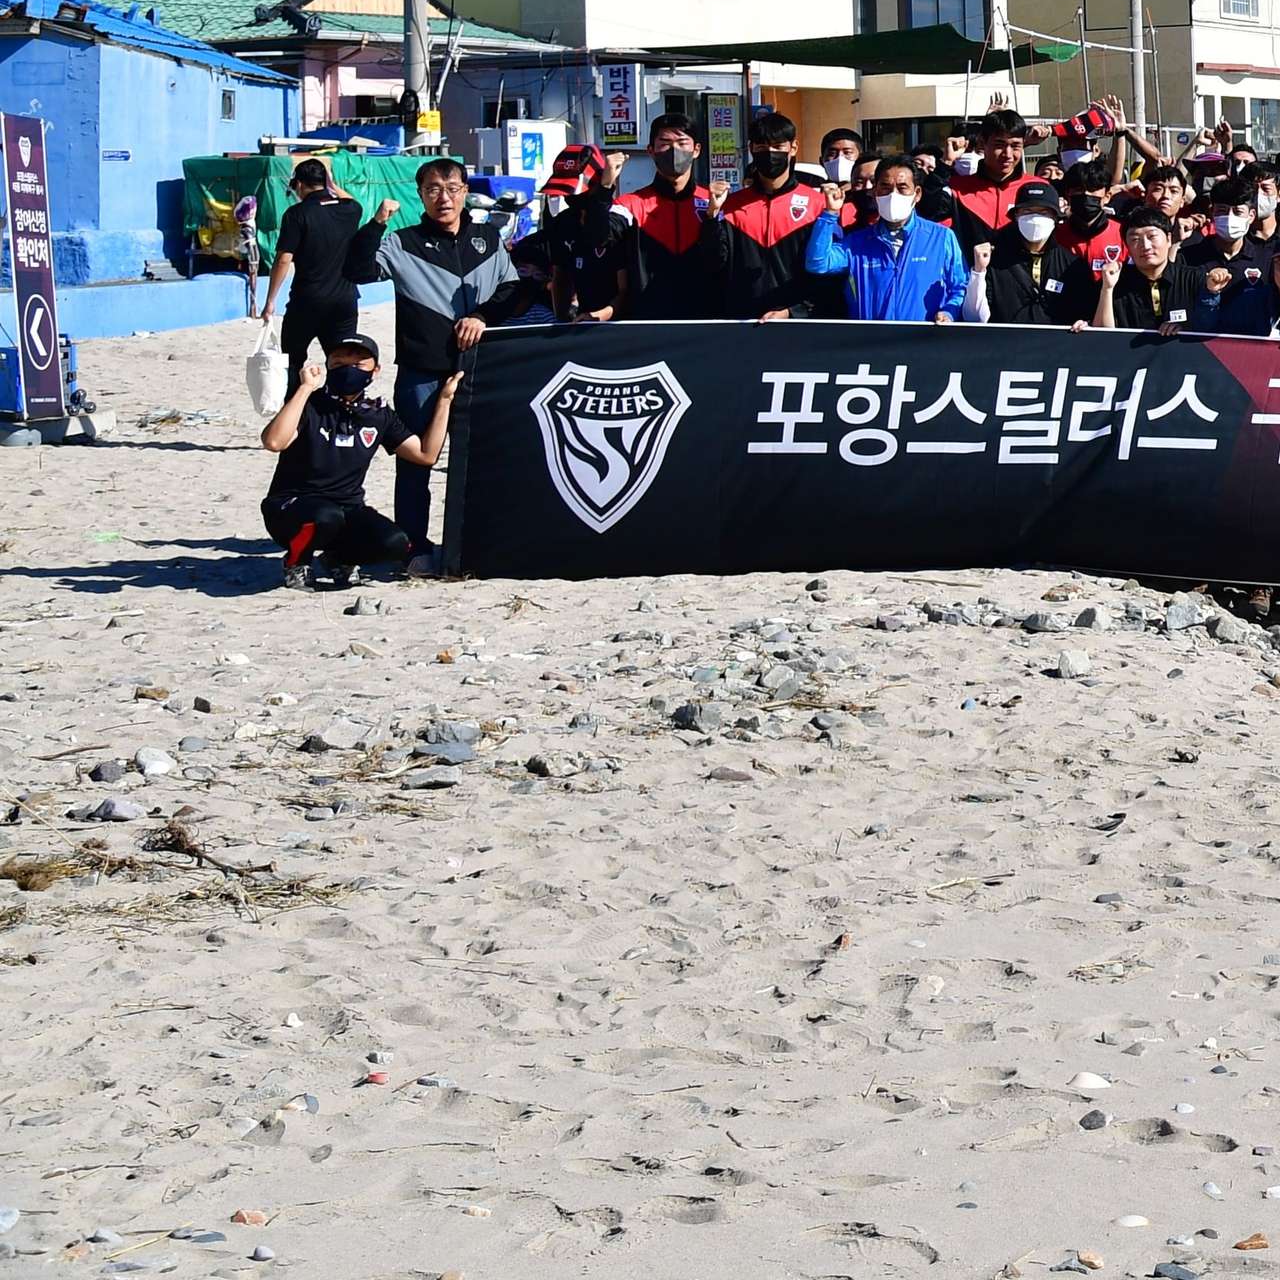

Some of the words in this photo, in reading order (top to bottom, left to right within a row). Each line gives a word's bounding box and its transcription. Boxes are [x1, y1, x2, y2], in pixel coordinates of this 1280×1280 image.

[608, 66, 632, 121] 바다수퍼
[606, 123, 635, 135] 민박
[14, 208, 47, 234] 참여신청
[16, 236, 50, 269] 확인처
[556, 389, 664, 416] STEELERS
[586, 385, 641, 396] POHANG
[748, 364, 1218, 466] 포항스틸러스
